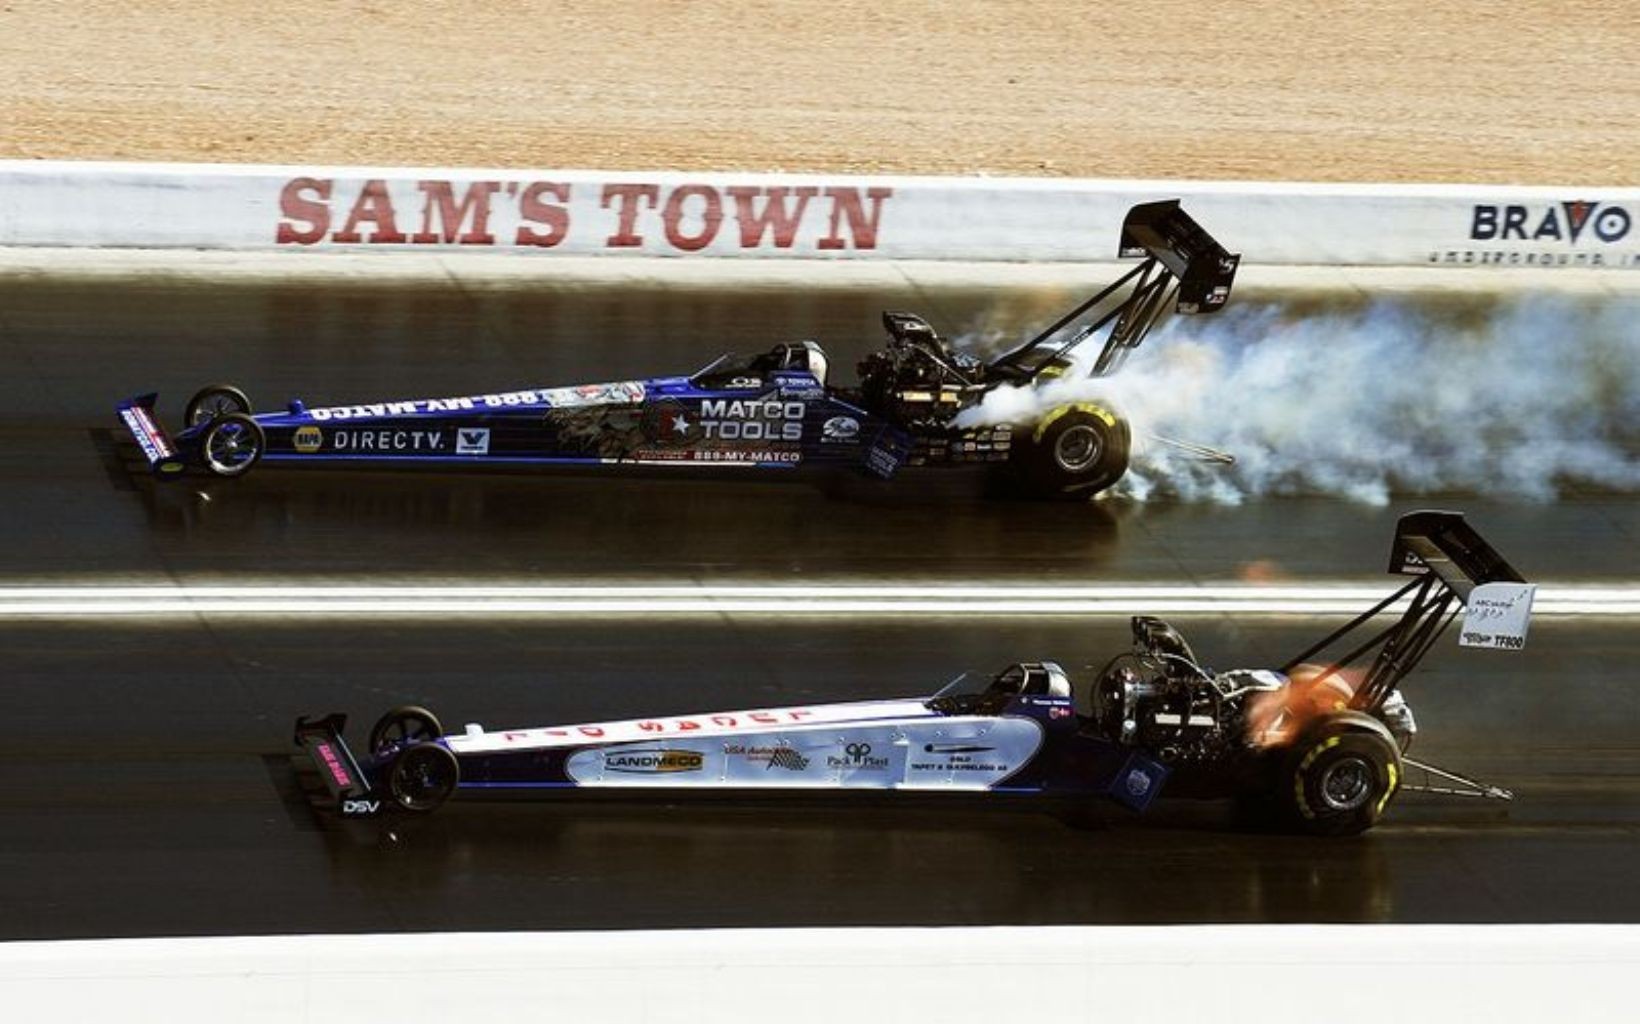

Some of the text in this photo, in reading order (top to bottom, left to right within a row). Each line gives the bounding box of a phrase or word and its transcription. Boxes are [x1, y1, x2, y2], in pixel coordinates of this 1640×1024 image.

[275, 177, 892, 251] SAM'S TOWN
[1470, 199, 1631, 246] BRAVO
[701, 400, 806, 419] MATCO
[700, 421, 803, 440] TOOLS
[605, 756, 703, 768] LANDMECO
[343, 800, 380, 813] DSV
